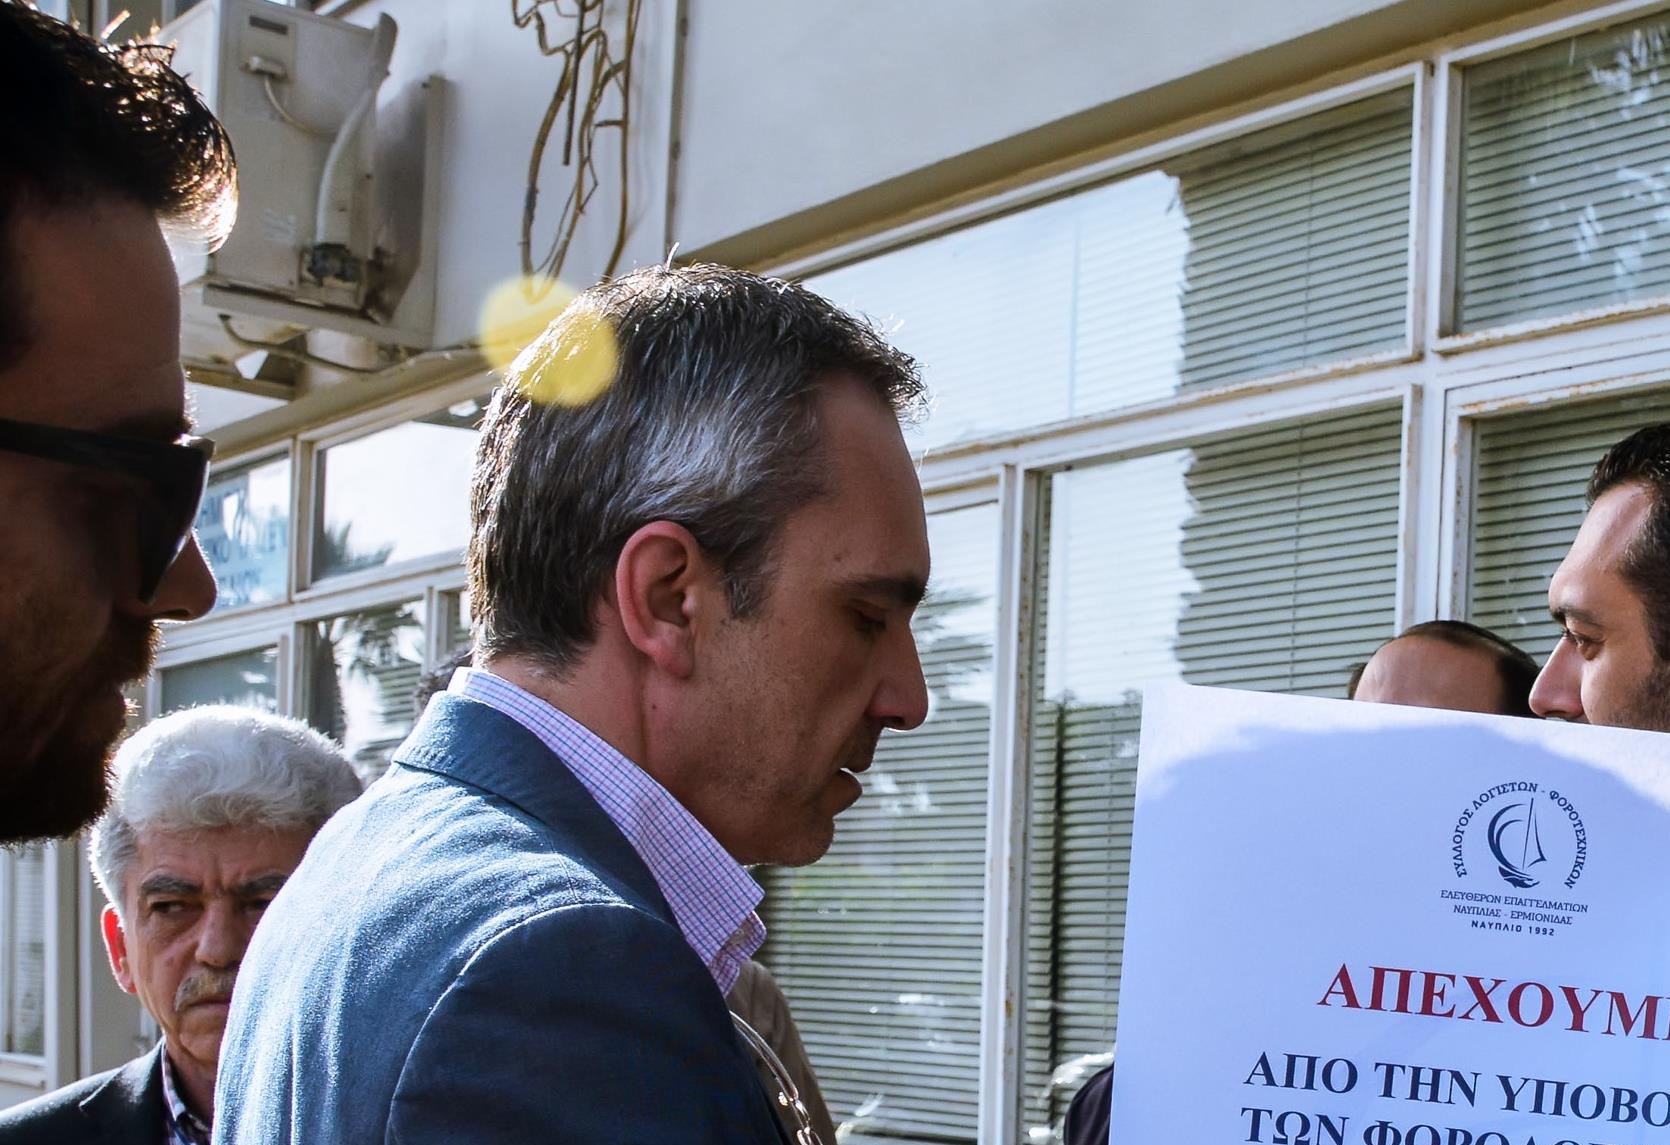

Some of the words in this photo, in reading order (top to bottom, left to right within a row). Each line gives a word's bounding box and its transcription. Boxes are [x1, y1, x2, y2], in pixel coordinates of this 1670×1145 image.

[1452, 808, 1475, 879] ΣΥΛΛΟΓΟΣ
[1471, 781, 1538, 812] ΛΟΓΙΣΤΩΝ
[1549, 789, 1587, 890] ΦΟΡΟΤΕΧΝΙΚΩΝ
[1440, 889, 1502, 905] ΕΛΕΥΘΕΡΩΝ
[1503, 896, 1588, 914] ΕΠΑΓΓΕΛΜΑΤΙΩΝ
[1453, 904, 1502, 919] ΝΑΥΠΛΙΑΣ
[1510, 910, 1573, 926] ΕΡΜΙΟΝΙΔΑΣ
[1471, 919, 1523, 934] ΝΑΥΠΛΙΟ
[1528, 925, 1556, 937] 1992
[1243, 1050, 1359, 1095] ΑΠΟ
[1373, 1061, 1483, 1108] ΤΗΝ
